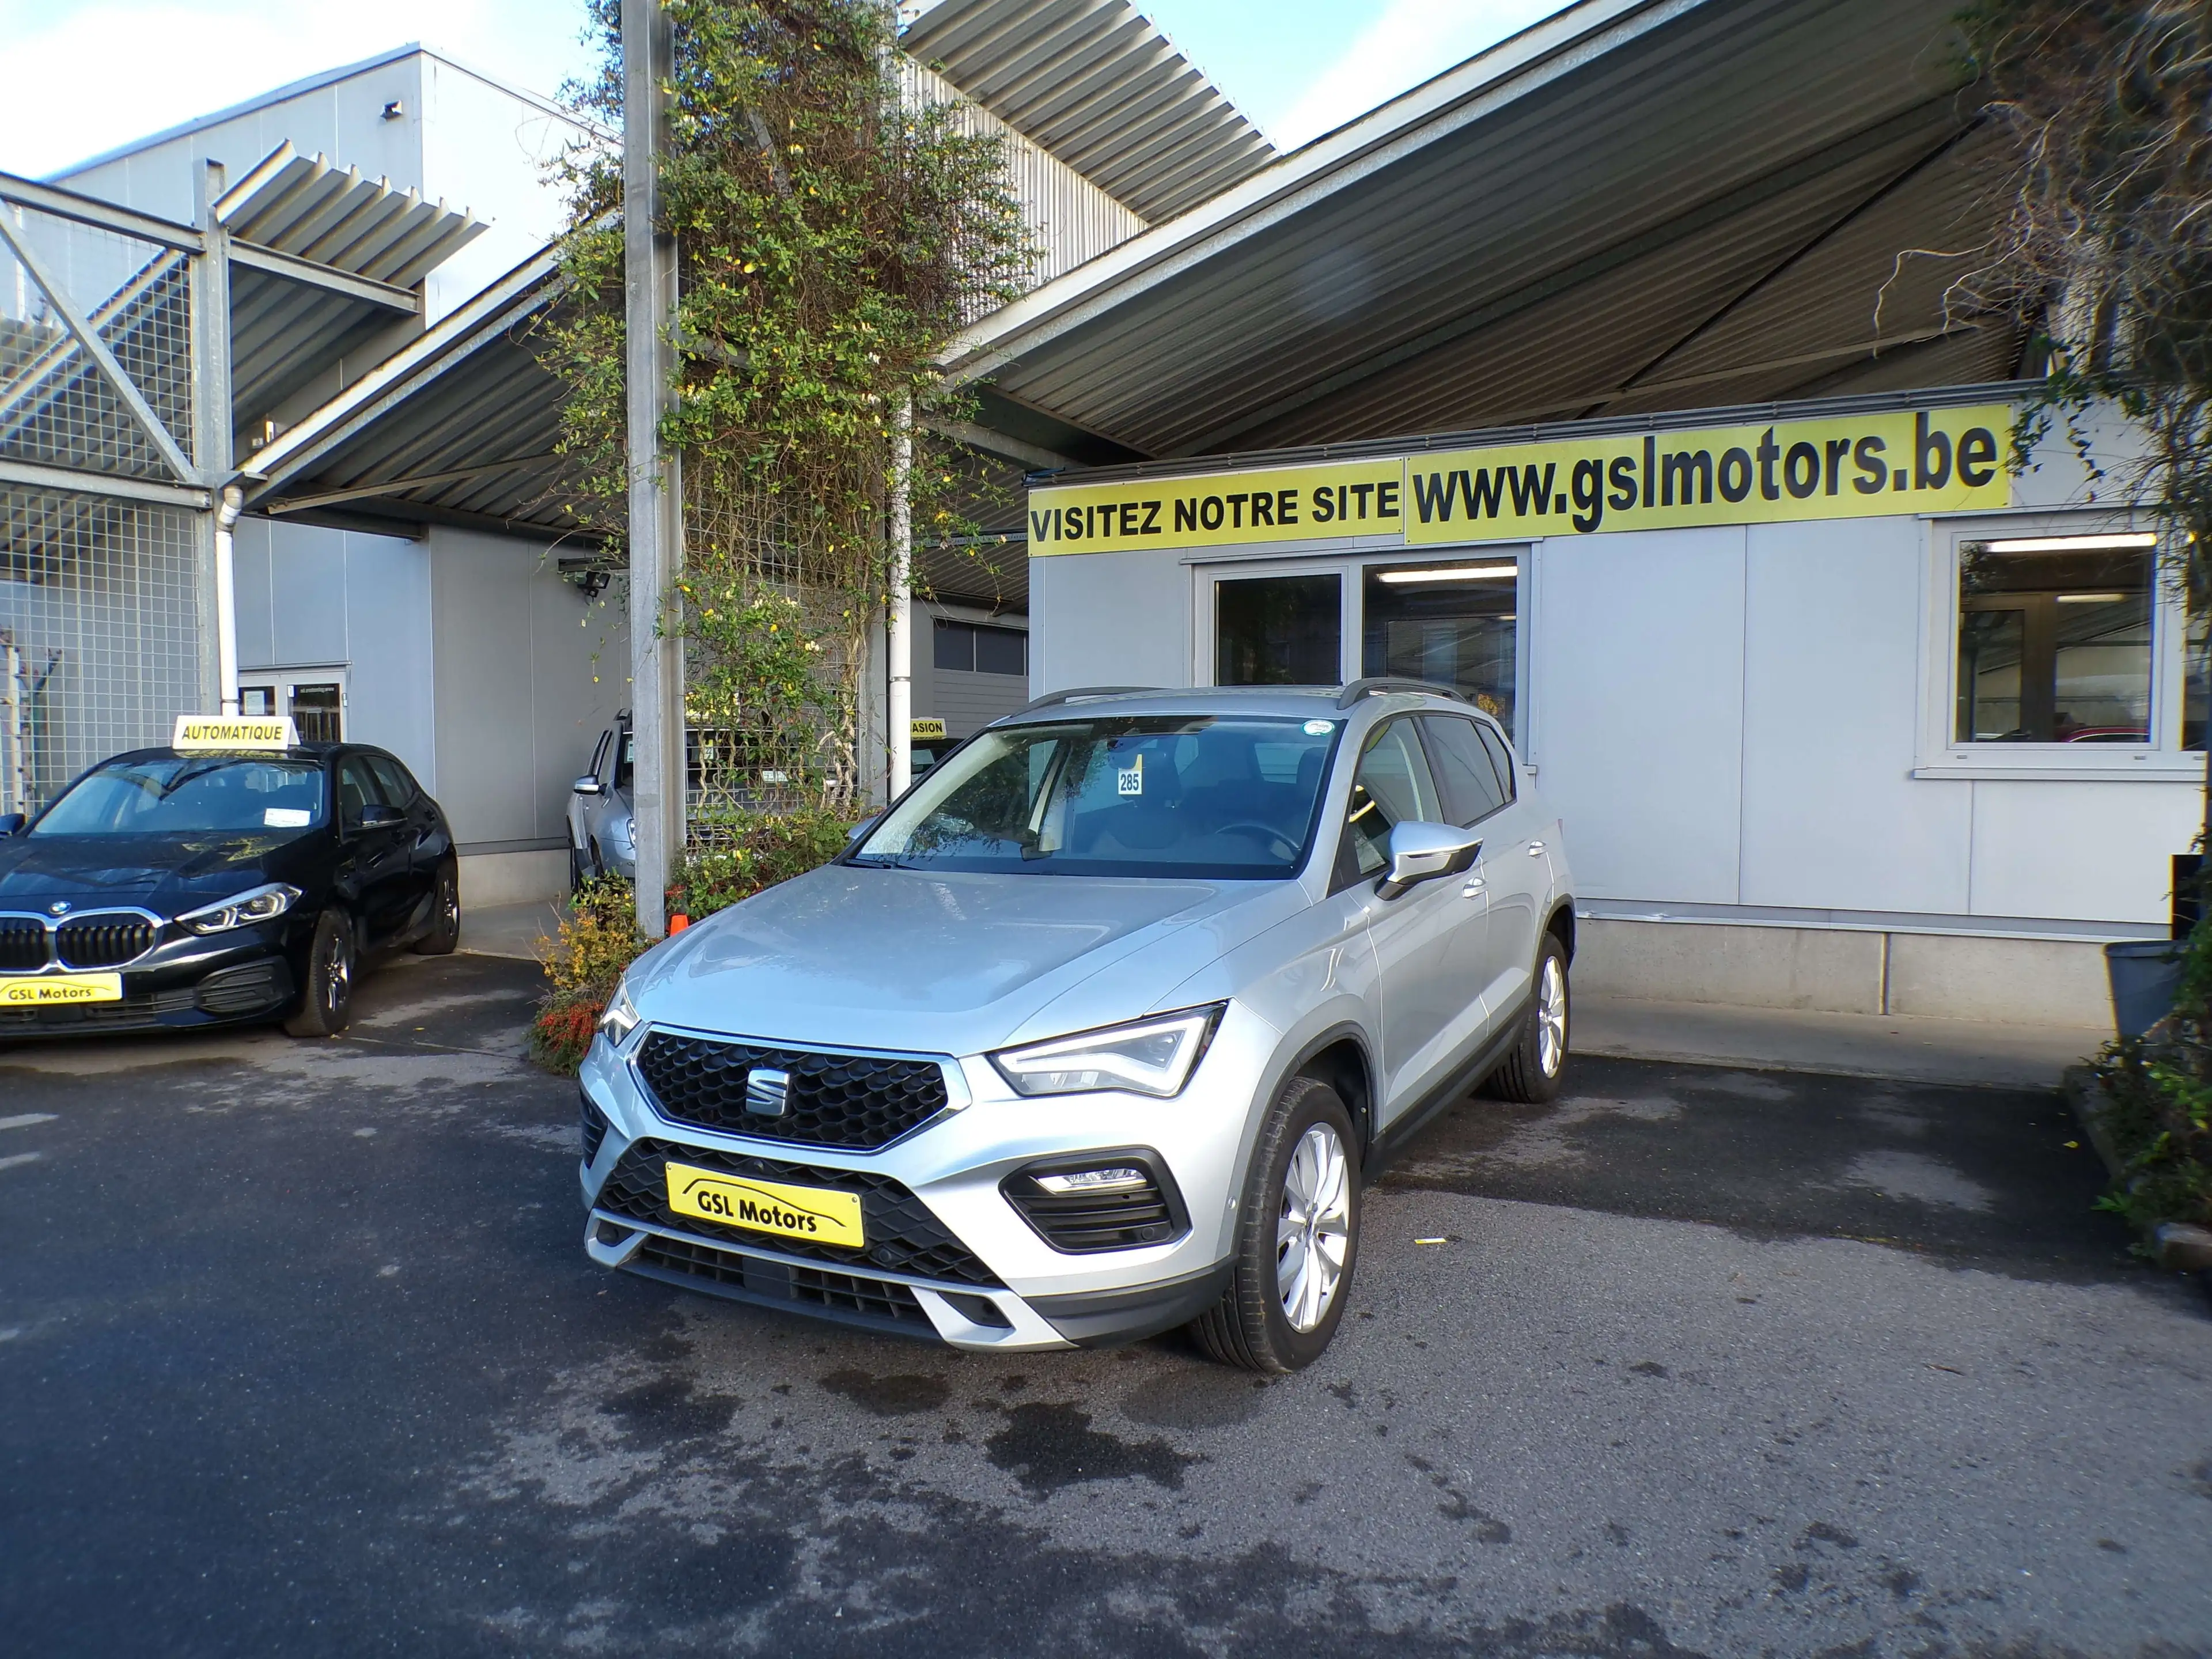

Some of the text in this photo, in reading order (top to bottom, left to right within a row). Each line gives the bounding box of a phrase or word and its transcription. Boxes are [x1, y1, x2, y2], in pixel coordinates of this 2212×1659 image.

[1030, 411, 1998, 543] VISITEZ NOTRE SITE www.gslmotors.be
[181, 726, 283, 740] AUTOMATIQUE
[1120, 773, 1139, 791] 285
[8, 987, 92, 1000] GSL Motors
[697, 1190, 817, 1233] GSL Motors
